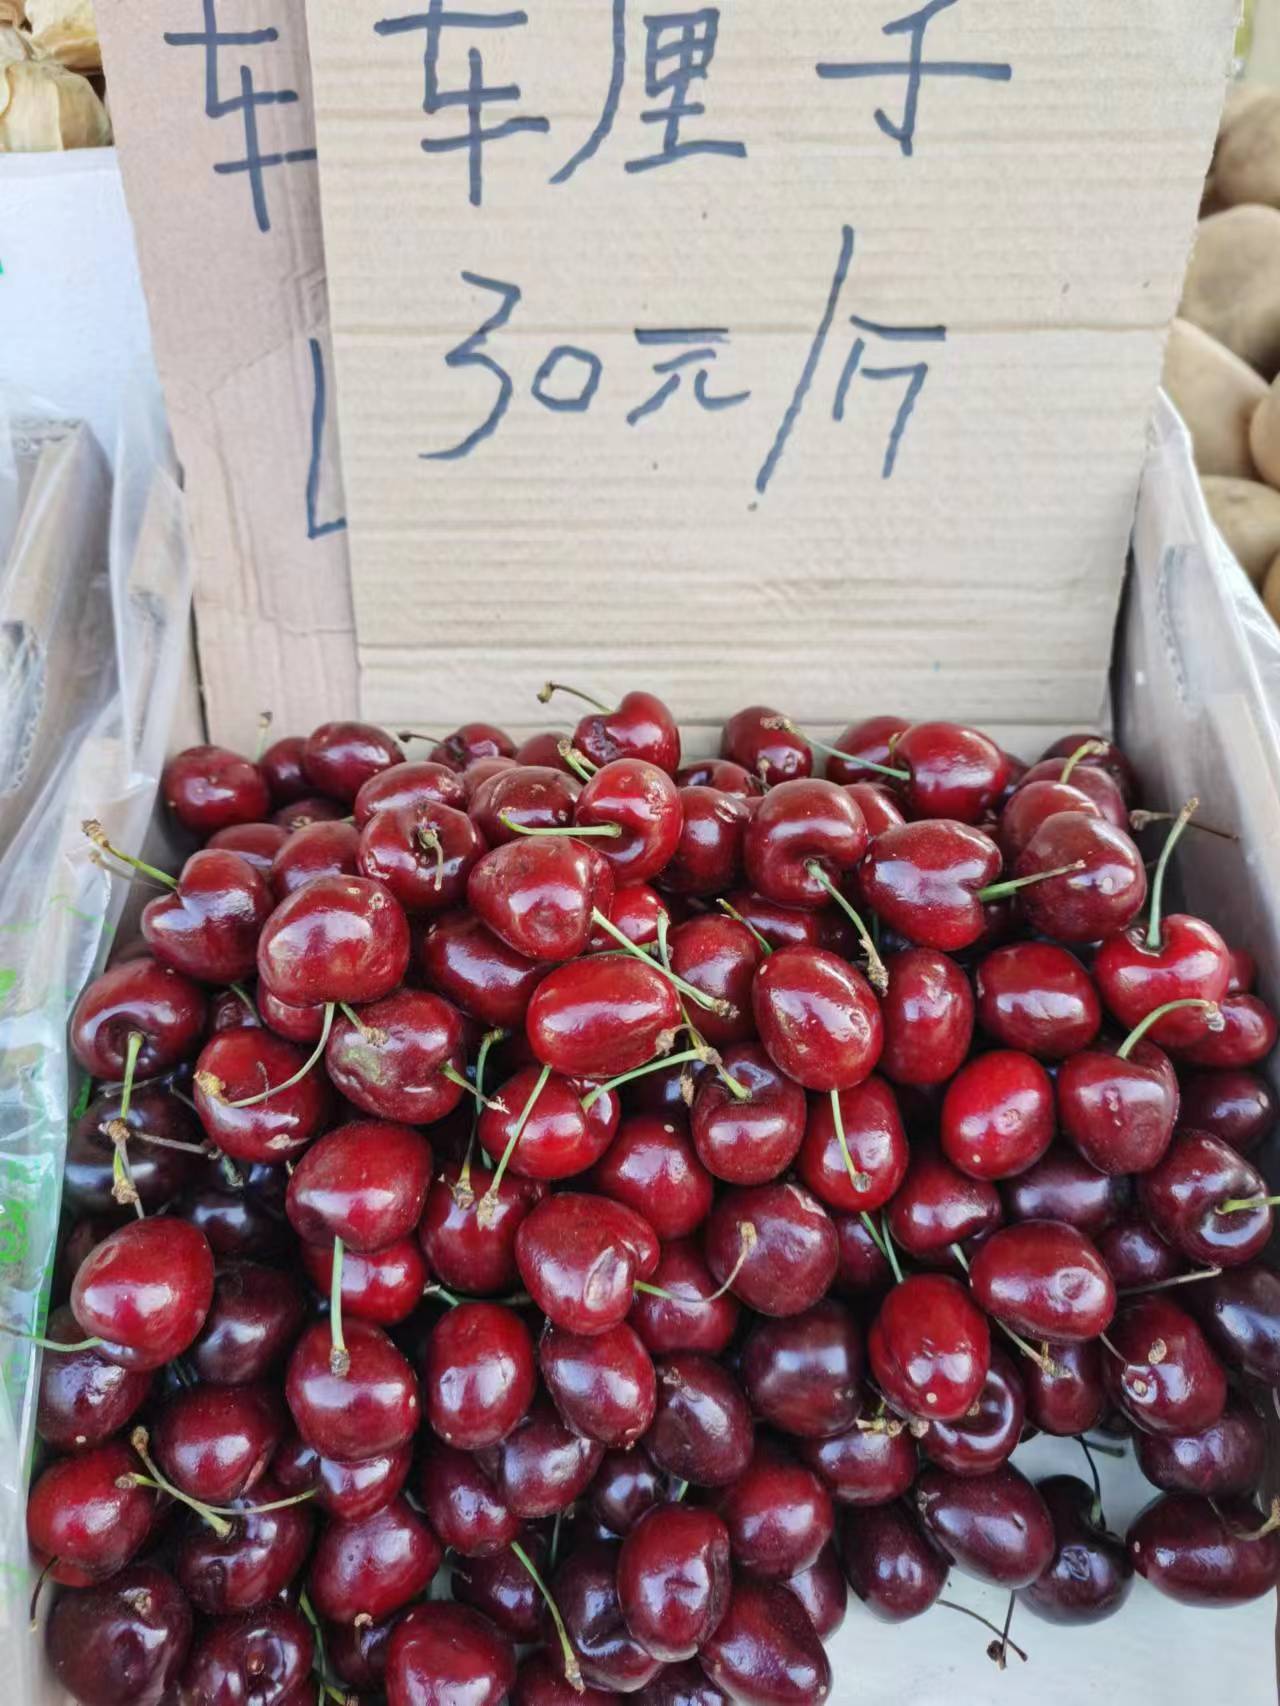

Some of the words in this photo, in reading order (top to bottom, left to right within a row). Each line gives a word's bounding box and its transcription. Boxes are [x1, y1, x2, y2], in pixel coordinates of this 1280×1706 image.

[164, 0, 316, 232] 车
[374, 0, 1012, 206] 车厘子
[418, 225, 947, 493] 30元/斤
